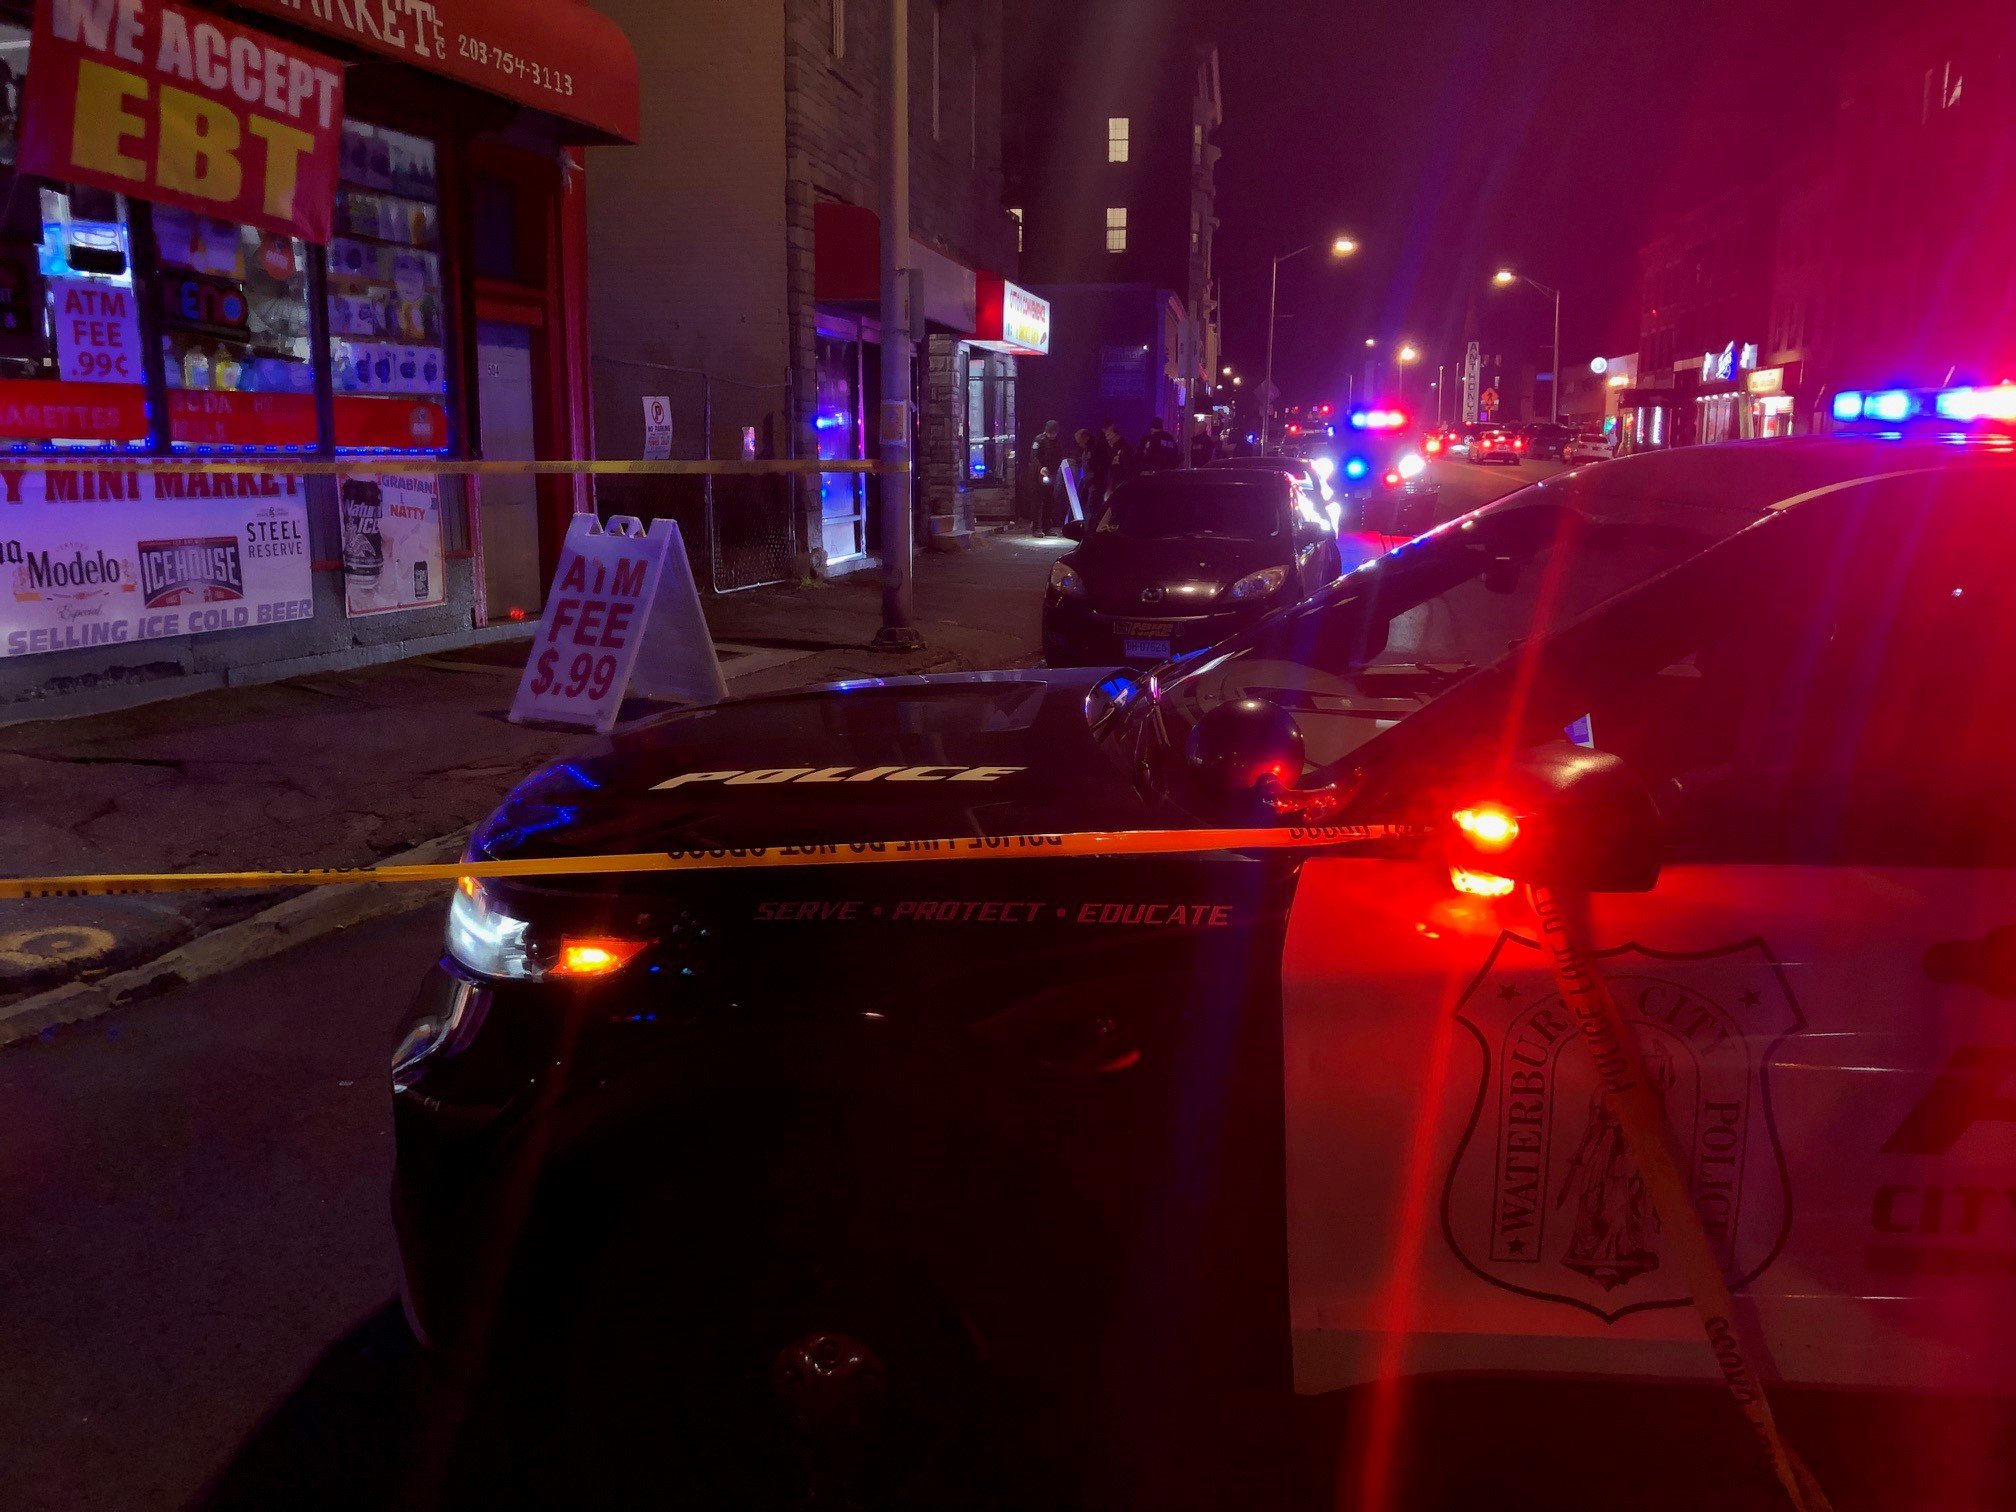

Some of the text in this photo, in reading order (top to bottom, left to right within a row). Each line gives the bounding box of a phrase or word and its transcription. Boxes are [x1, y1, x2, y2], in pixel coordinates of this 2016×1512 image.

[52, 0, 339, 129] WE ACCEPT
[458, 33, 574, 97] 203-754-3113
[69, 57, 316, 221] EBT
[65, 288, 126, 318] ATM
[72, 319, 124, 347] FEE
[45, 458, 140, 502] MINI
[154, 458, 300, 499] MARKET
[246, 520, 301, 543] STEEL
[390, 504, 426, 520] NATTY
[26, 550, 121, 589] Modelo
[141, 546, 242, 595] ICEHOUSE
[248, 541, 303, 558] RESERVE
[8, 598, 314, 655] SELLING ICE COLD BEER
[547, 597, 636, 650] FEE
[530, 647, 618, 701] $.99
[648, 765, 1030, 792] POLICE
[752, 900, 1236, 927] SERVE PROTECT EDUCATE
[1500, 1002, 1569, 1235] WATERBUR
[1638, 985, 1739, 1054] CITY
